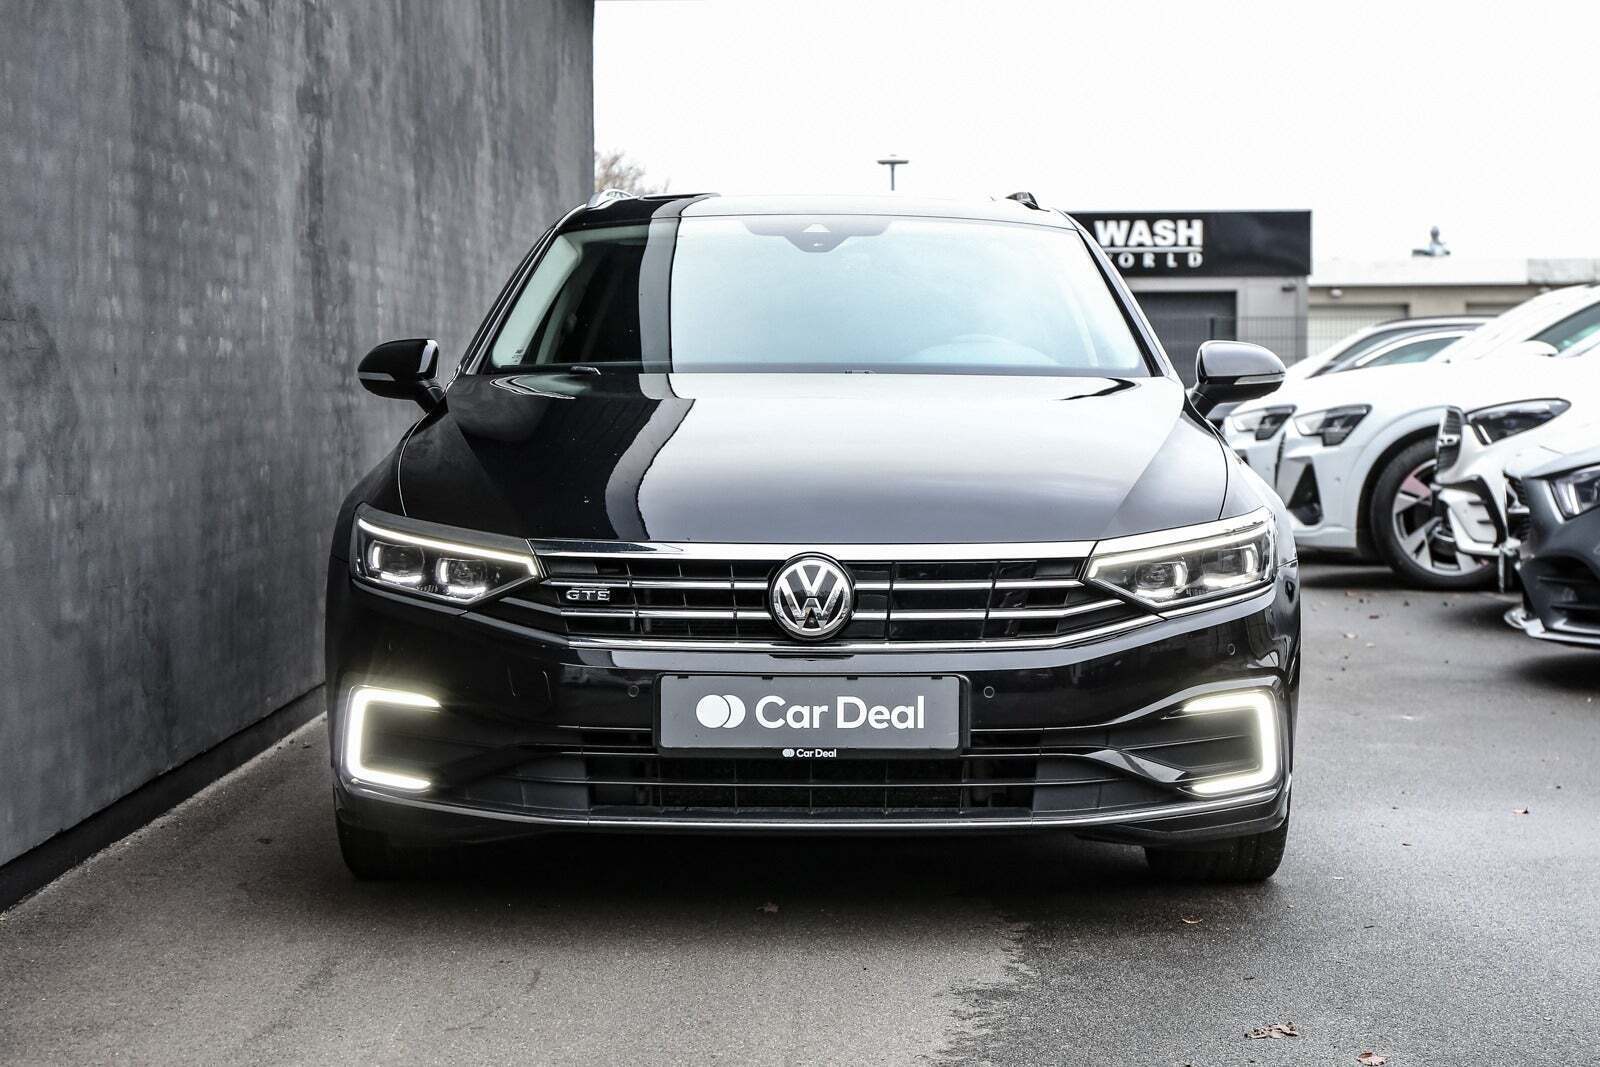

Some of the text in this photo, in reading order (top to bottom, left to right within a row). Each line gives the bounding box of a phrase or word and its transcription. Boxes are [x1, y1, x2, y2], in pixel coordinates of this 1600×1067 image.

[1094, 219, 1204, 247] WASH
[1107, 252, 1203, 268] ORLD
[566, 590, 610, 600] GTE
[755, 695, 925, 729] Car Deal
[796, 748, 837, 758] Car Deal
